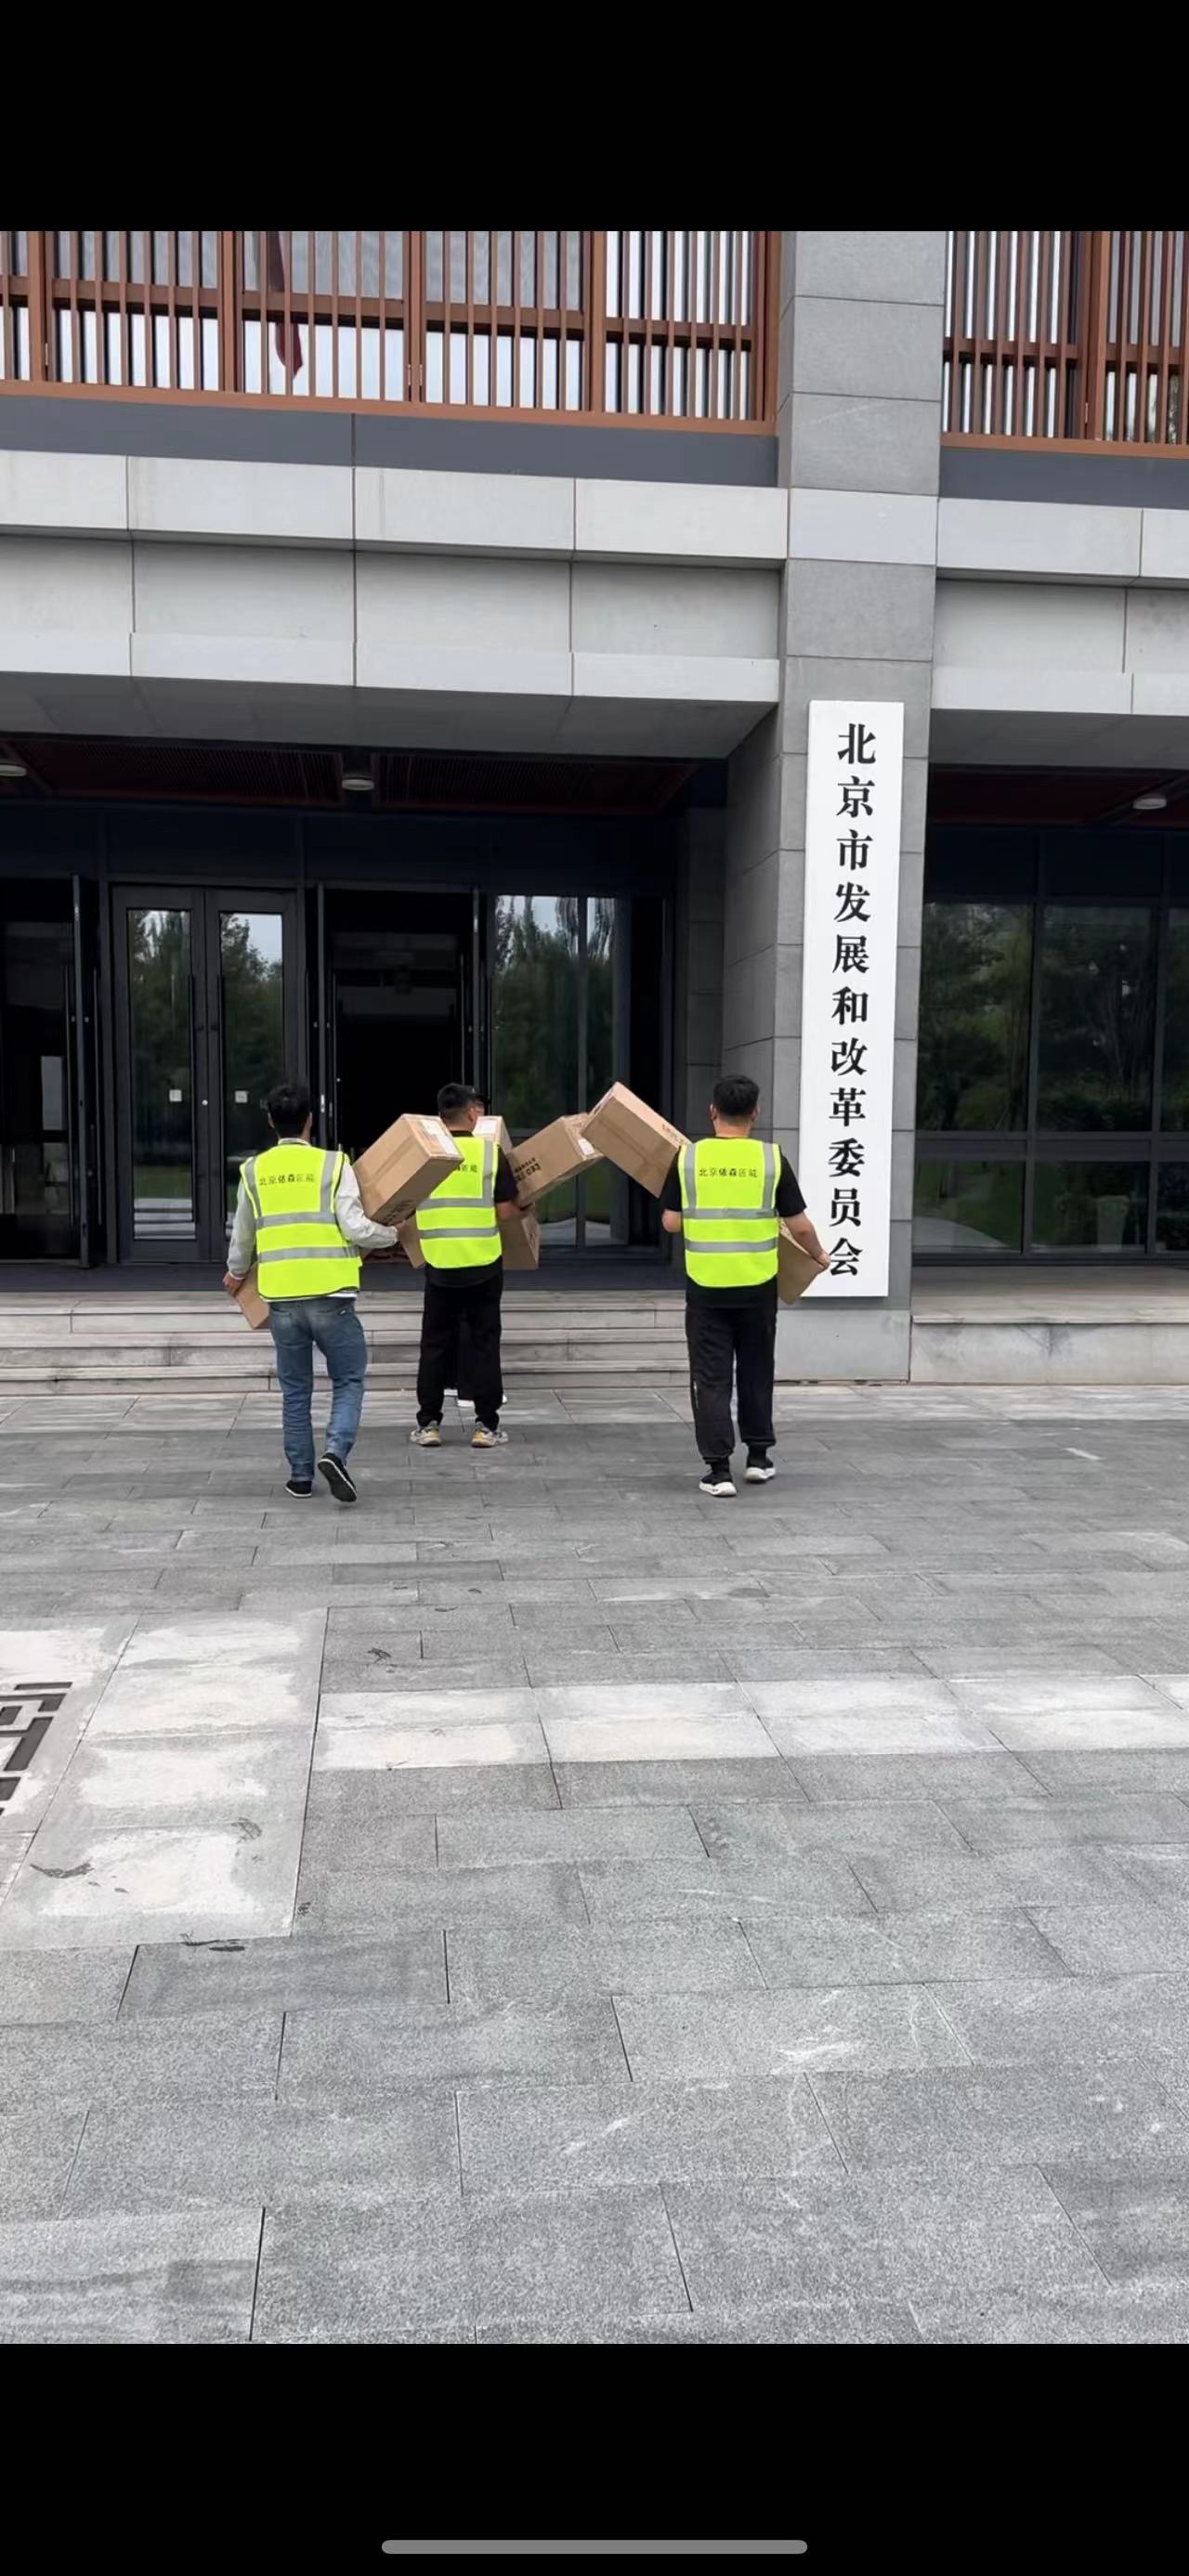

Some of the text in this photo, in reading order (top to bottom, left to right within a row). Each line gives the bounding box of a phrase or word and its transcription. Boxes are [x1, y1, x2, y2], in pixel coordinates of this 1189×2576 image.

[829, 722, 877, 1276] 北京市发展和改革委员会
